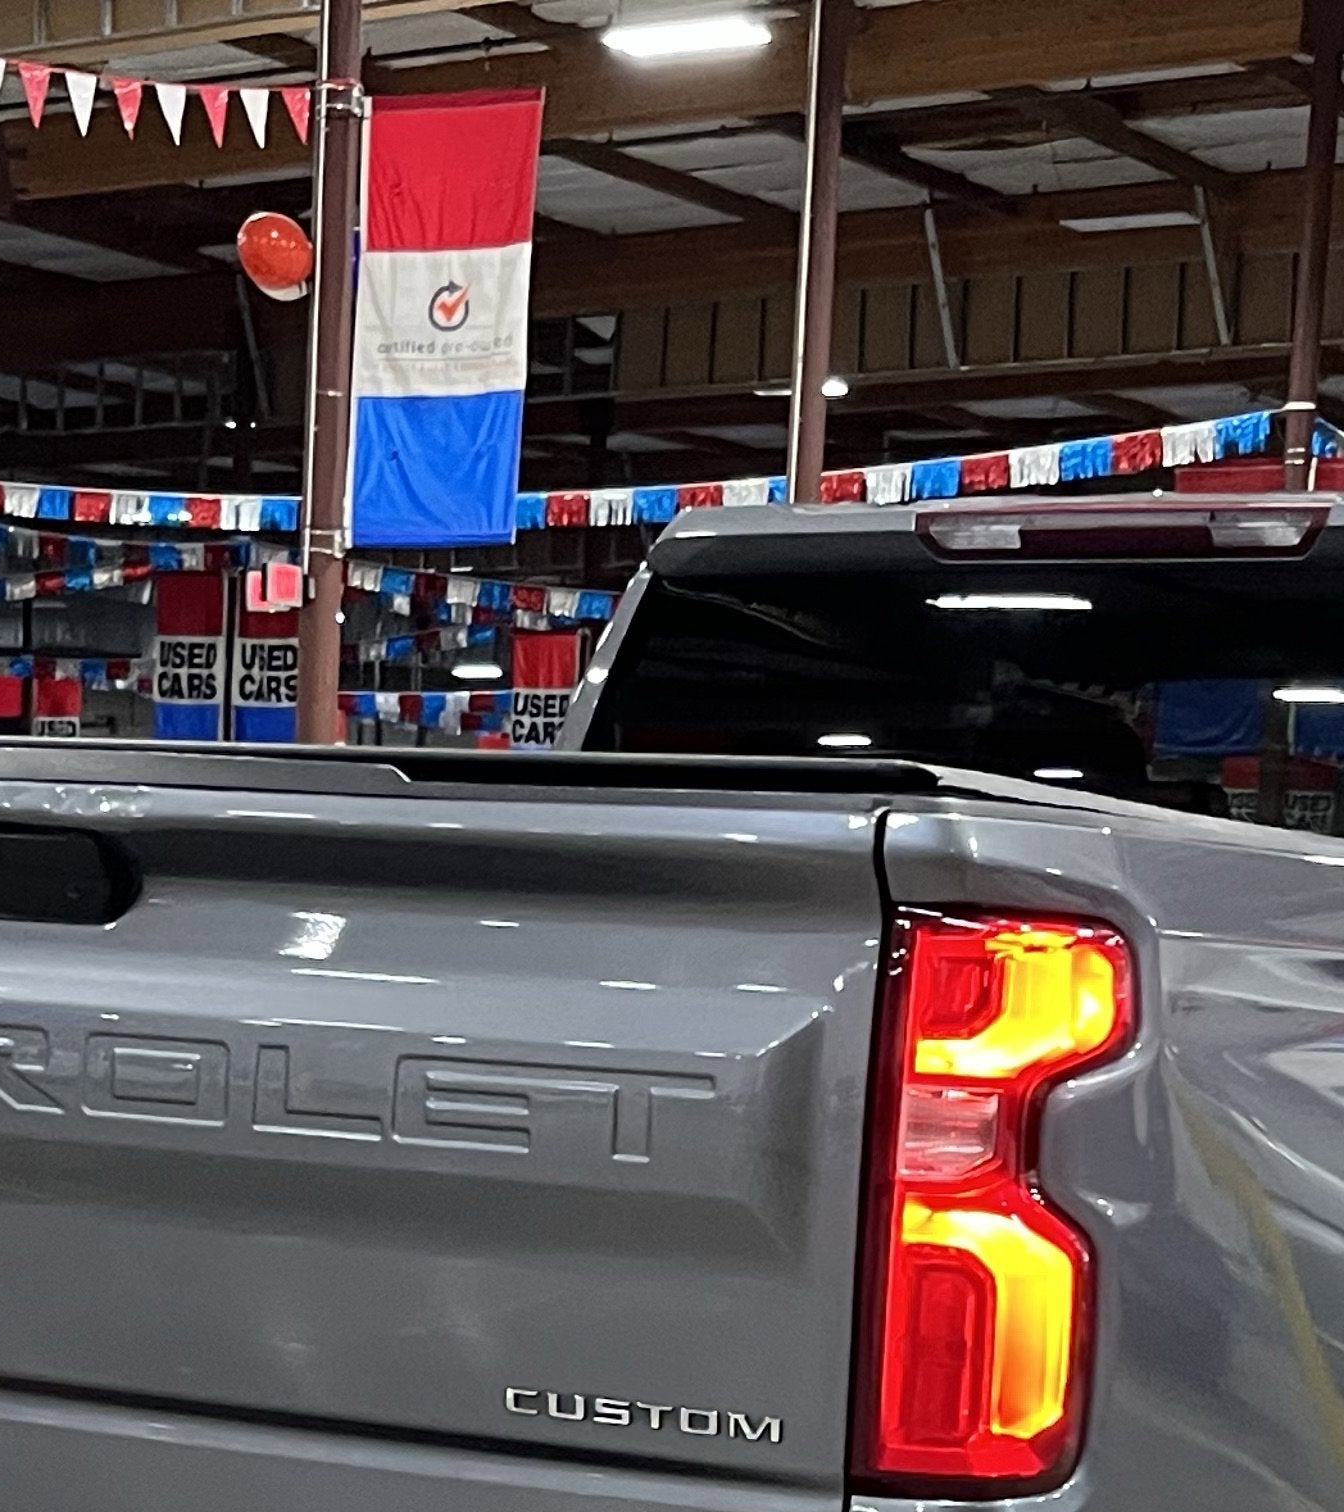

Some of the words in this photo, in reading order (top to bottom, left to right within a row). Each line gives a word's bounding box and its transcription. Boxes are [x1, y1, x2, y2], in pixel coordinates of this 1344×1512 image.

[159, 641, 217, 669] USED
[241, 643, 298, 671] USED
[158, 671, 217, 700] CARS
[239, 674, 298, 702] CARS
[513, 692, 570, 718] USED
[512, 718, 565, 745] CAR
[505, 1387, 782, 1443] CUSTOM
